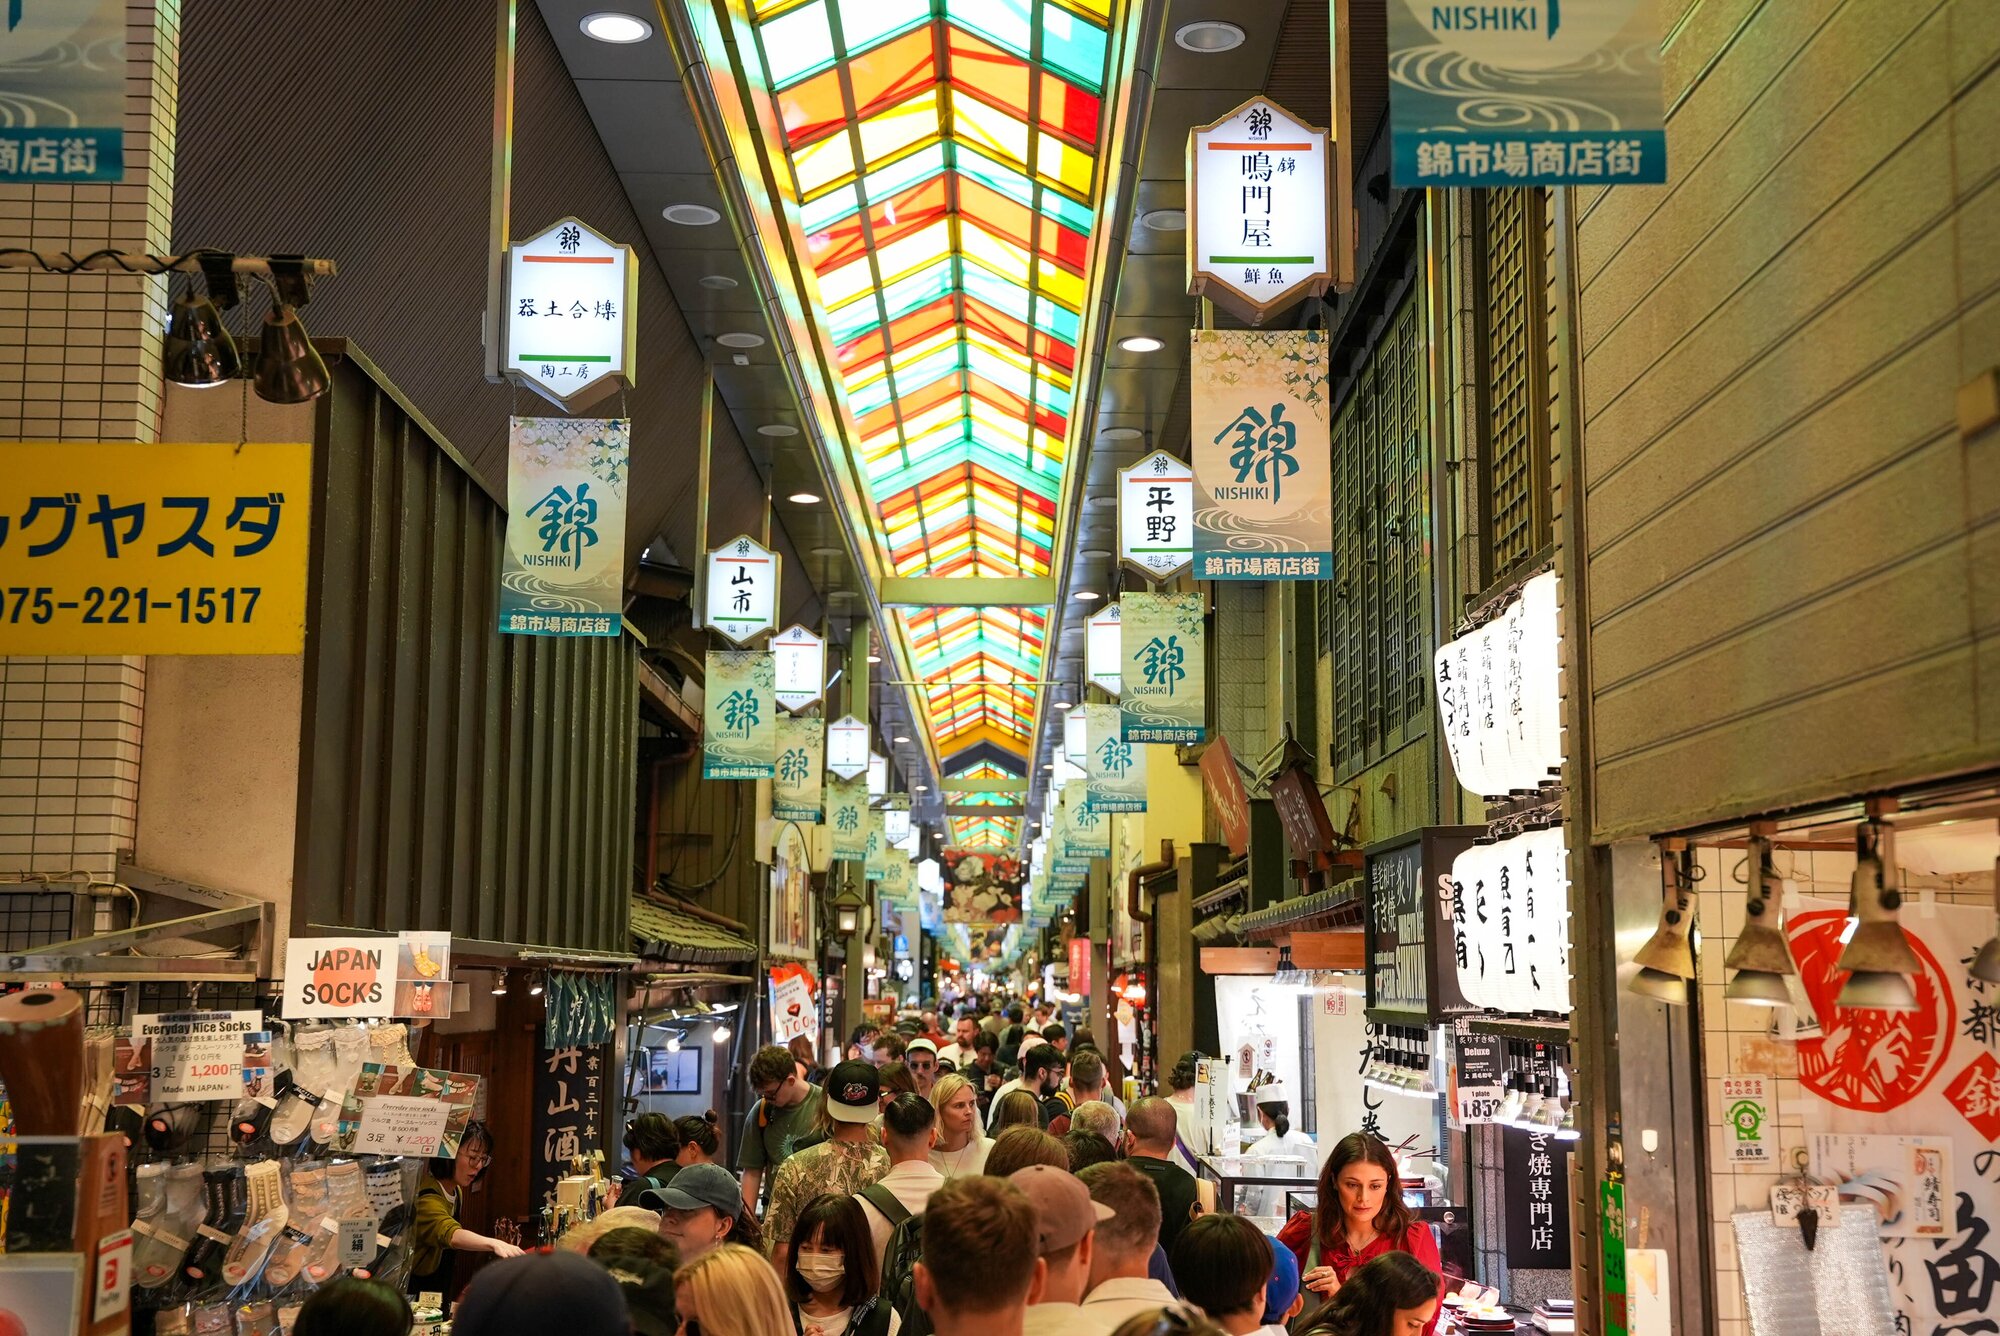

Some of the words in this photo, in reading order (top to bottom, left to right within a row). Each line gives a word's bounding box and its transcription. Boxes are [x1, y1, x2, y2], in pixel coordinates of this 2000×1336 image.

[1432, 6, 1537, 31] NISHIKI
[1244, 108, 1272, 140] 錦
[1416, 140, 1642, 178] 錦市場商店街
[1241, 151, 1273, 247] 鳴門屋
[556, 225, 581, 254] 錦
[1244, 267, 1284, 285] 鮮魚
[540, 363, 590, 380] 陶工房
[1213, 402, 1300, 506] 錦
[1214, 486, 1269, 500] NISHIKI
[0, 492, 286, 559] グヤスダ
[1146, 486, 1176, 543] 平野
[525, 482, 599, 572] 錦
[523, 554, 571, 567] NISHIKI
[1205, 557, 1320, 576] 錦市場商店街
[731, 566, 754, 614] 山市
[0, 587, 262, 625] 75-221-1517
[509, 614, 611, 633] 錦市場商店街
[1133, 634, 1186, 698] 錦
[1134, 686, 1167, 695] NISHIKI
[716, 688, 760, 741] 錦
[715, 731, 745, 739] NISHIKI
[1127, 728, 1198, 742] 錦市場商店街
[776, 747, 809, 790] 錦
[1095, 736, 1133, 780] 錦
[709, 767, 769, 778] 錦市場商店街
[1091, 801, 1143, 812] 錦市場商店街
[833, 806, 858, 836] 錦
[306, 949, 382, 971] JAPAN
[302, 982, 383, 1005] SOCKS
[142, 1023, 190, 1035] Everyday
[192, 1022, 217, 1033] Nice
[218, 1021, 252, 1032] Socks
[1464, 1047, 1490, 1056] Deluxe
[161, 1085, 184, 1093] Made
[186, 1084, 196, 1092] IN
[197, 1083, 224, 1092] JAPAN
